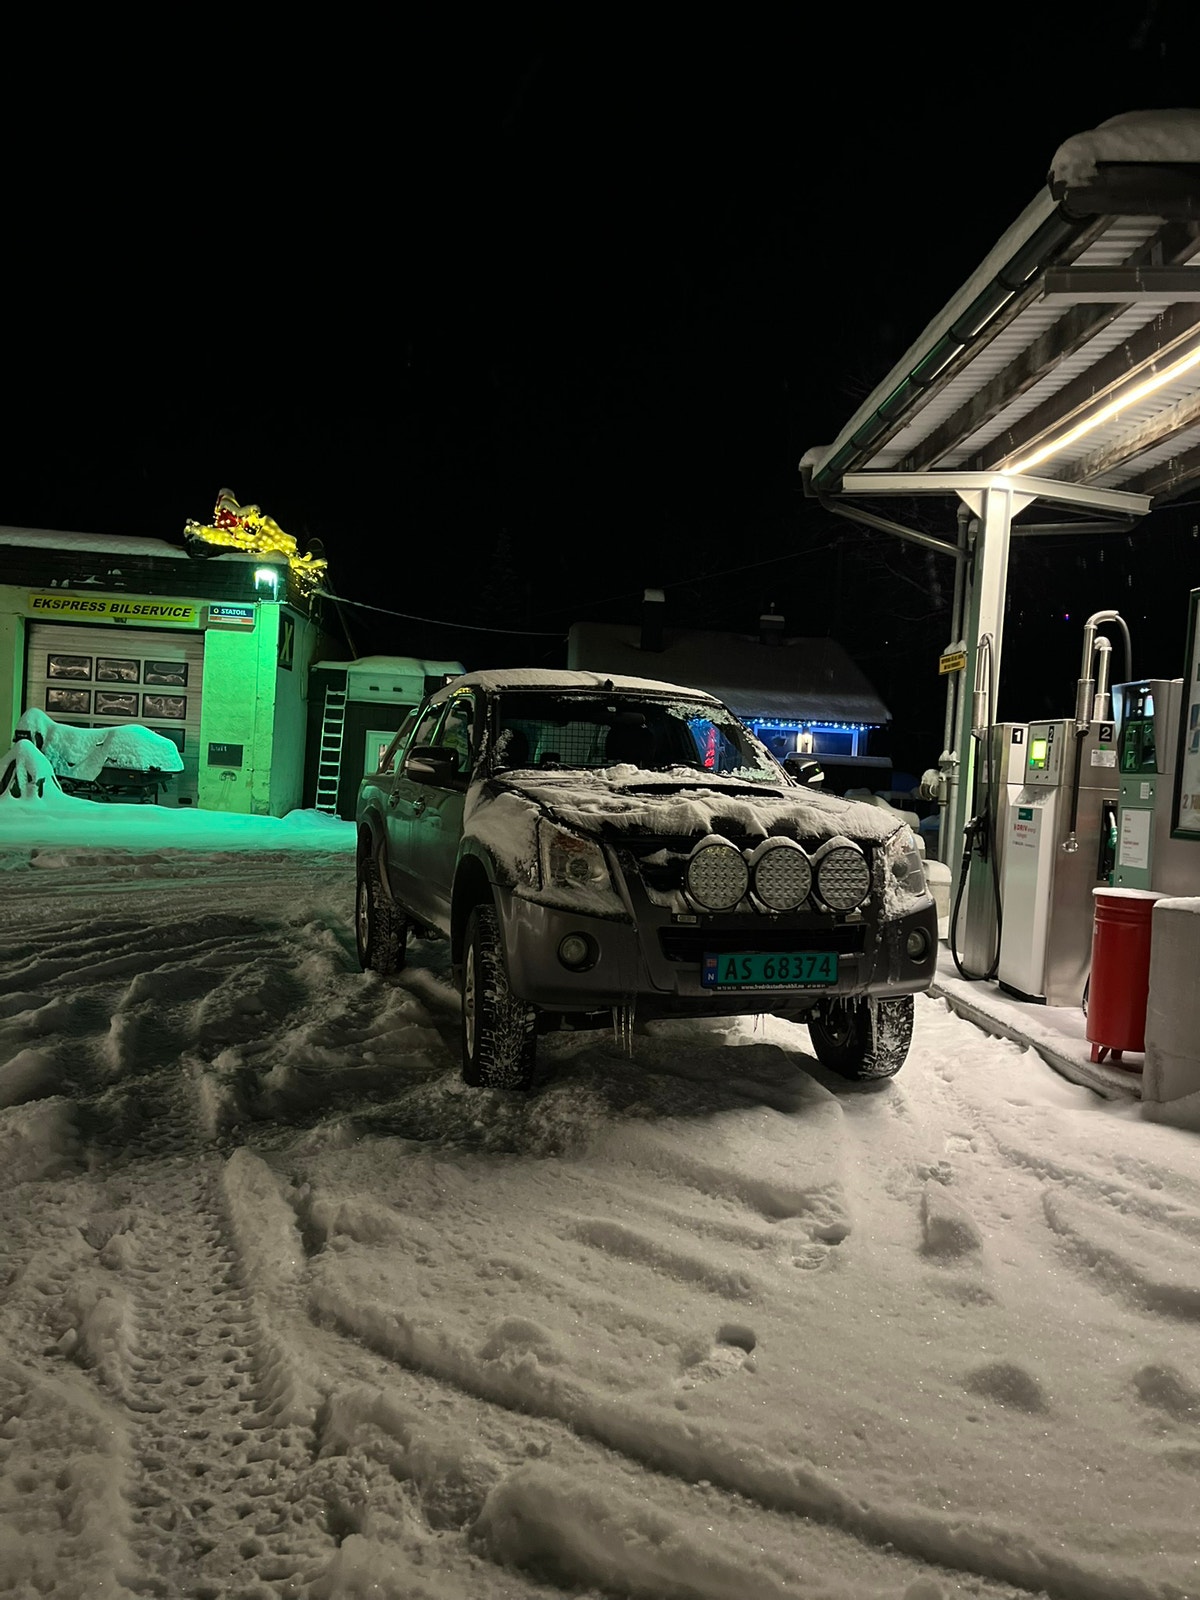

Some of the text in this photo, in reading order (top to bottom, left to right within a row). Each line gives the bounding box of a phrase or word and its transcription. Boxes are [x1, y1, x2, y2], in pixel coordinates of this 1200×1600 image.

[32, 598, 192, 618] EKSPRESS BILSERVICE
[220, 608, 247, 616] STATOIL
[1014, 730, 1022, 742] 1
[1048, 728, 1054, 741] 2
[1100, 727, 1111, 739] 2
[1182, 793, 1189, 809] 2
[724, 956, 831, 980] AS 68374
[707, 973, 715, 981] N
